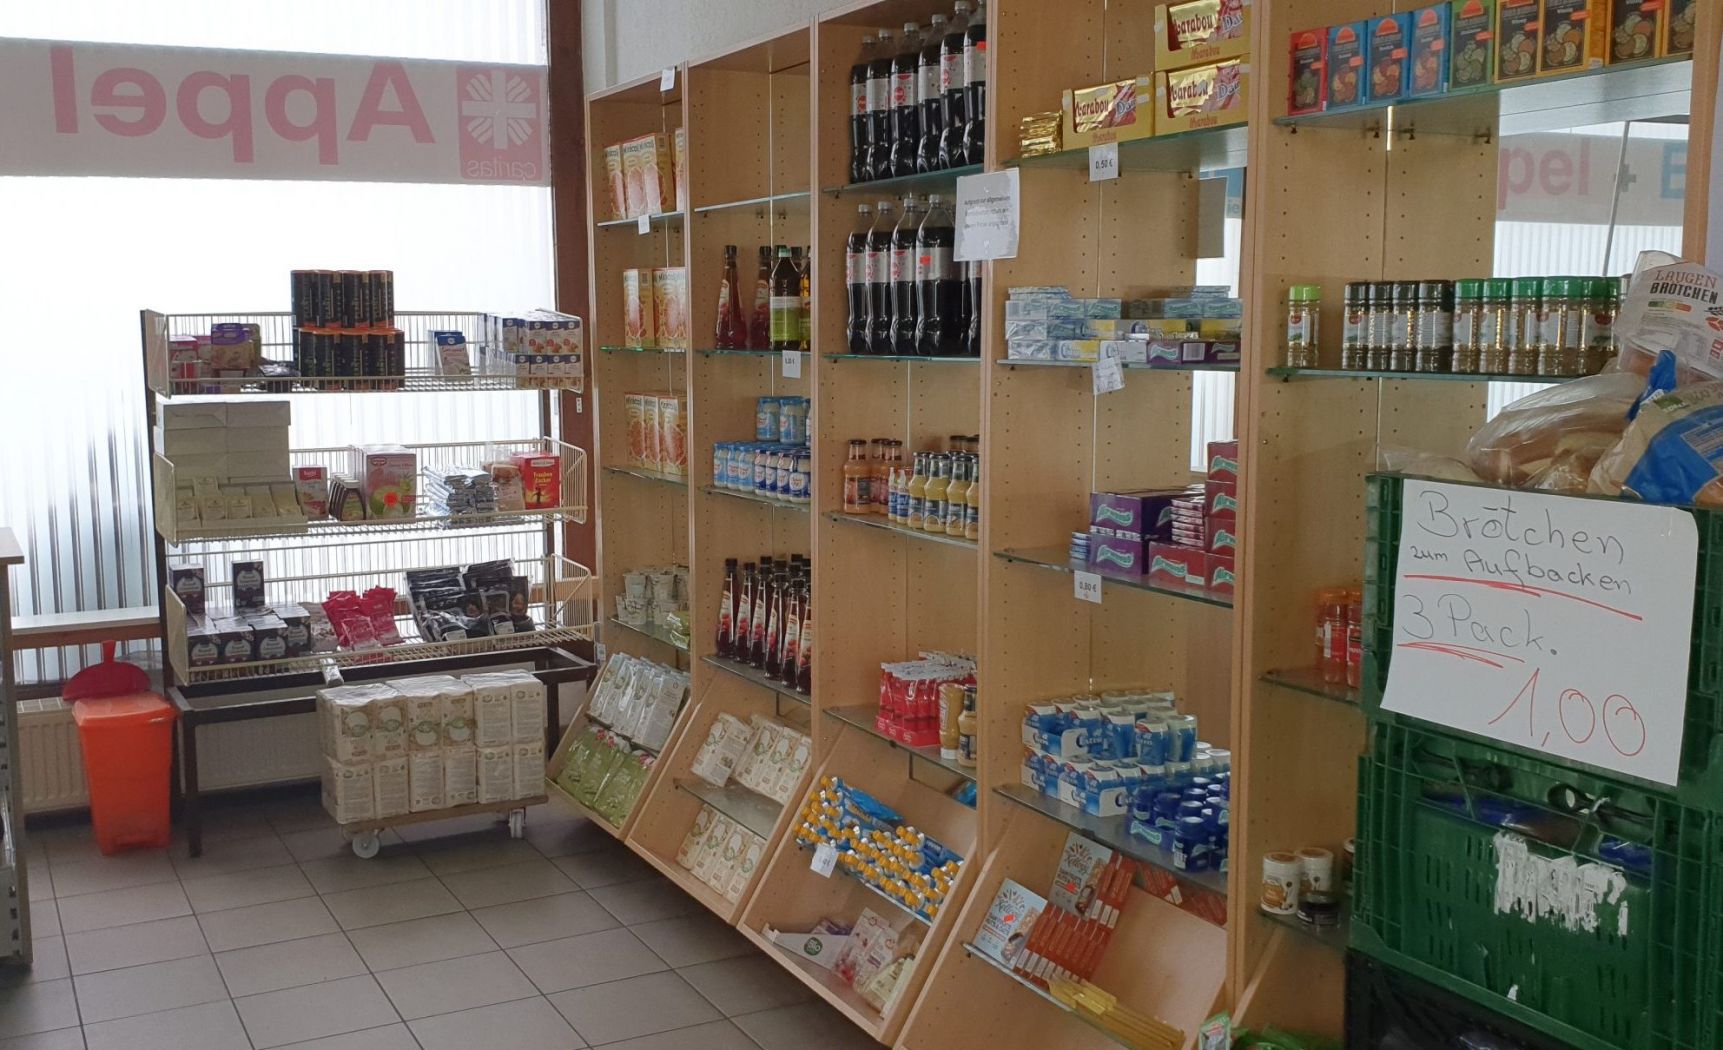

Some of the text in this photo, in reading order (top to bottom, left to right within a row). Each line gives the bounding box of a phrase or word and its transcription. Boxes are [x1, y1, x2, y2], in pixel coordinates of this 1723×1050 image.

[1655, 269, 1718, 289] LAUGEN
[1410, 546, 1631, 595] zum Aufbacken
[1401, 594, 1434, 640] 3
[1488, 667, 1646, 757] 1,00
